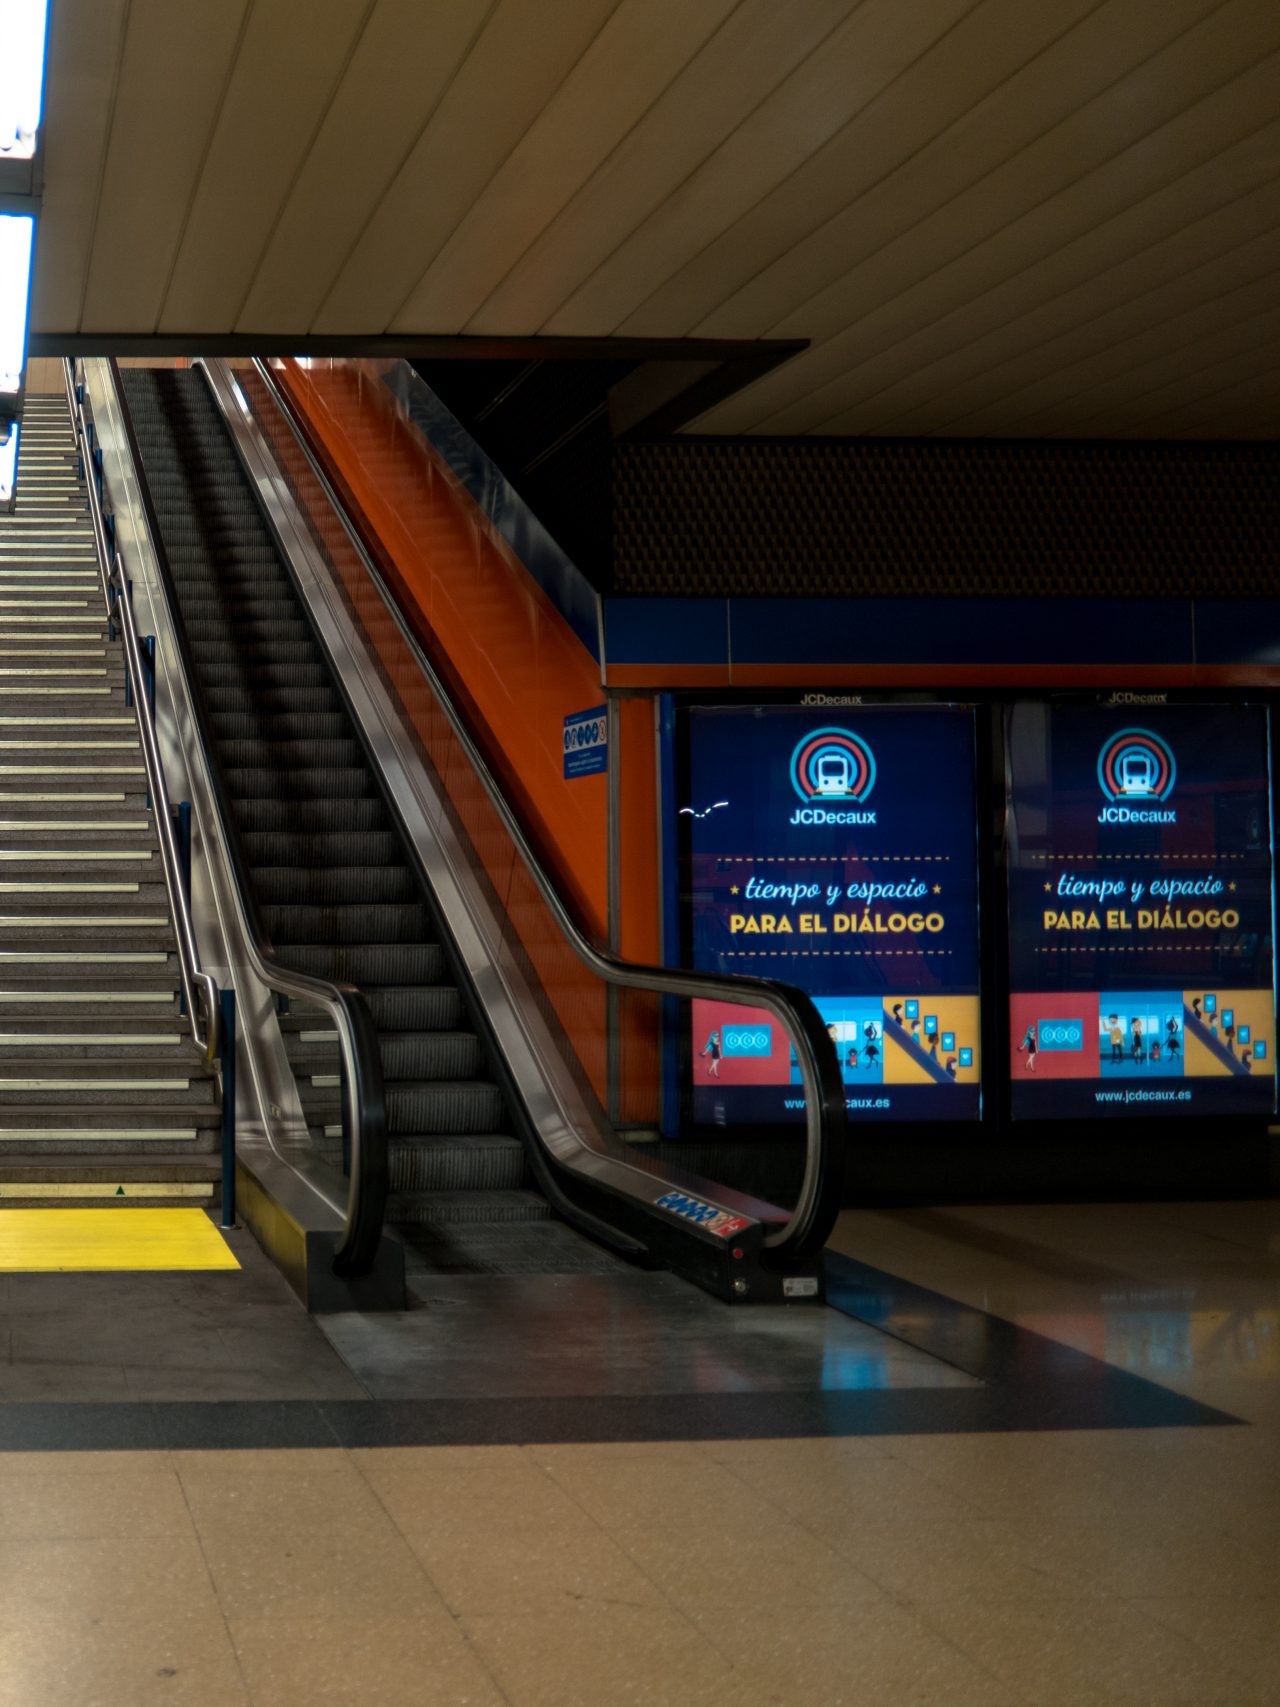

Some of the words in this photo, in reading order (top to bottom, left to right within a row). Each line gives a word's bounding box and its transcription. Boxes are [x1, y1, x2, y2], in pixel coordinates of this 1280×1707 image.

[800, 693, 862, 704] JCDecaux
[1108, 692, 1168, 704] JCDecaux
[789, 808, 877, 825] JCDecaux
[1097, 806, 1177, 824] JCDecaux
[745, 876, 822, 906] tiempo
[826, 884, 842, 907] y
[846, 876, 929, 905] espacio
[1056, 872, 1126, 902] tiempo
[1130, 881, 1146, 902] y
[1149, 873, 1225, 902] espacio
[730, 914, 794, 934] PARA
[799, 913, 828, 934] EL
[833, 907, 945, 933] DIÁLOGO
[1043, 910, 1101, 930] PARA
[1106, 909, 1133, 929] EL
[1137, 905, 1240, 929] DIÁLOGO
[784, 1098, 891, 1110] wwcaux.es
[1095, 1088, 1192, 1104] www.jcdecaux.es
